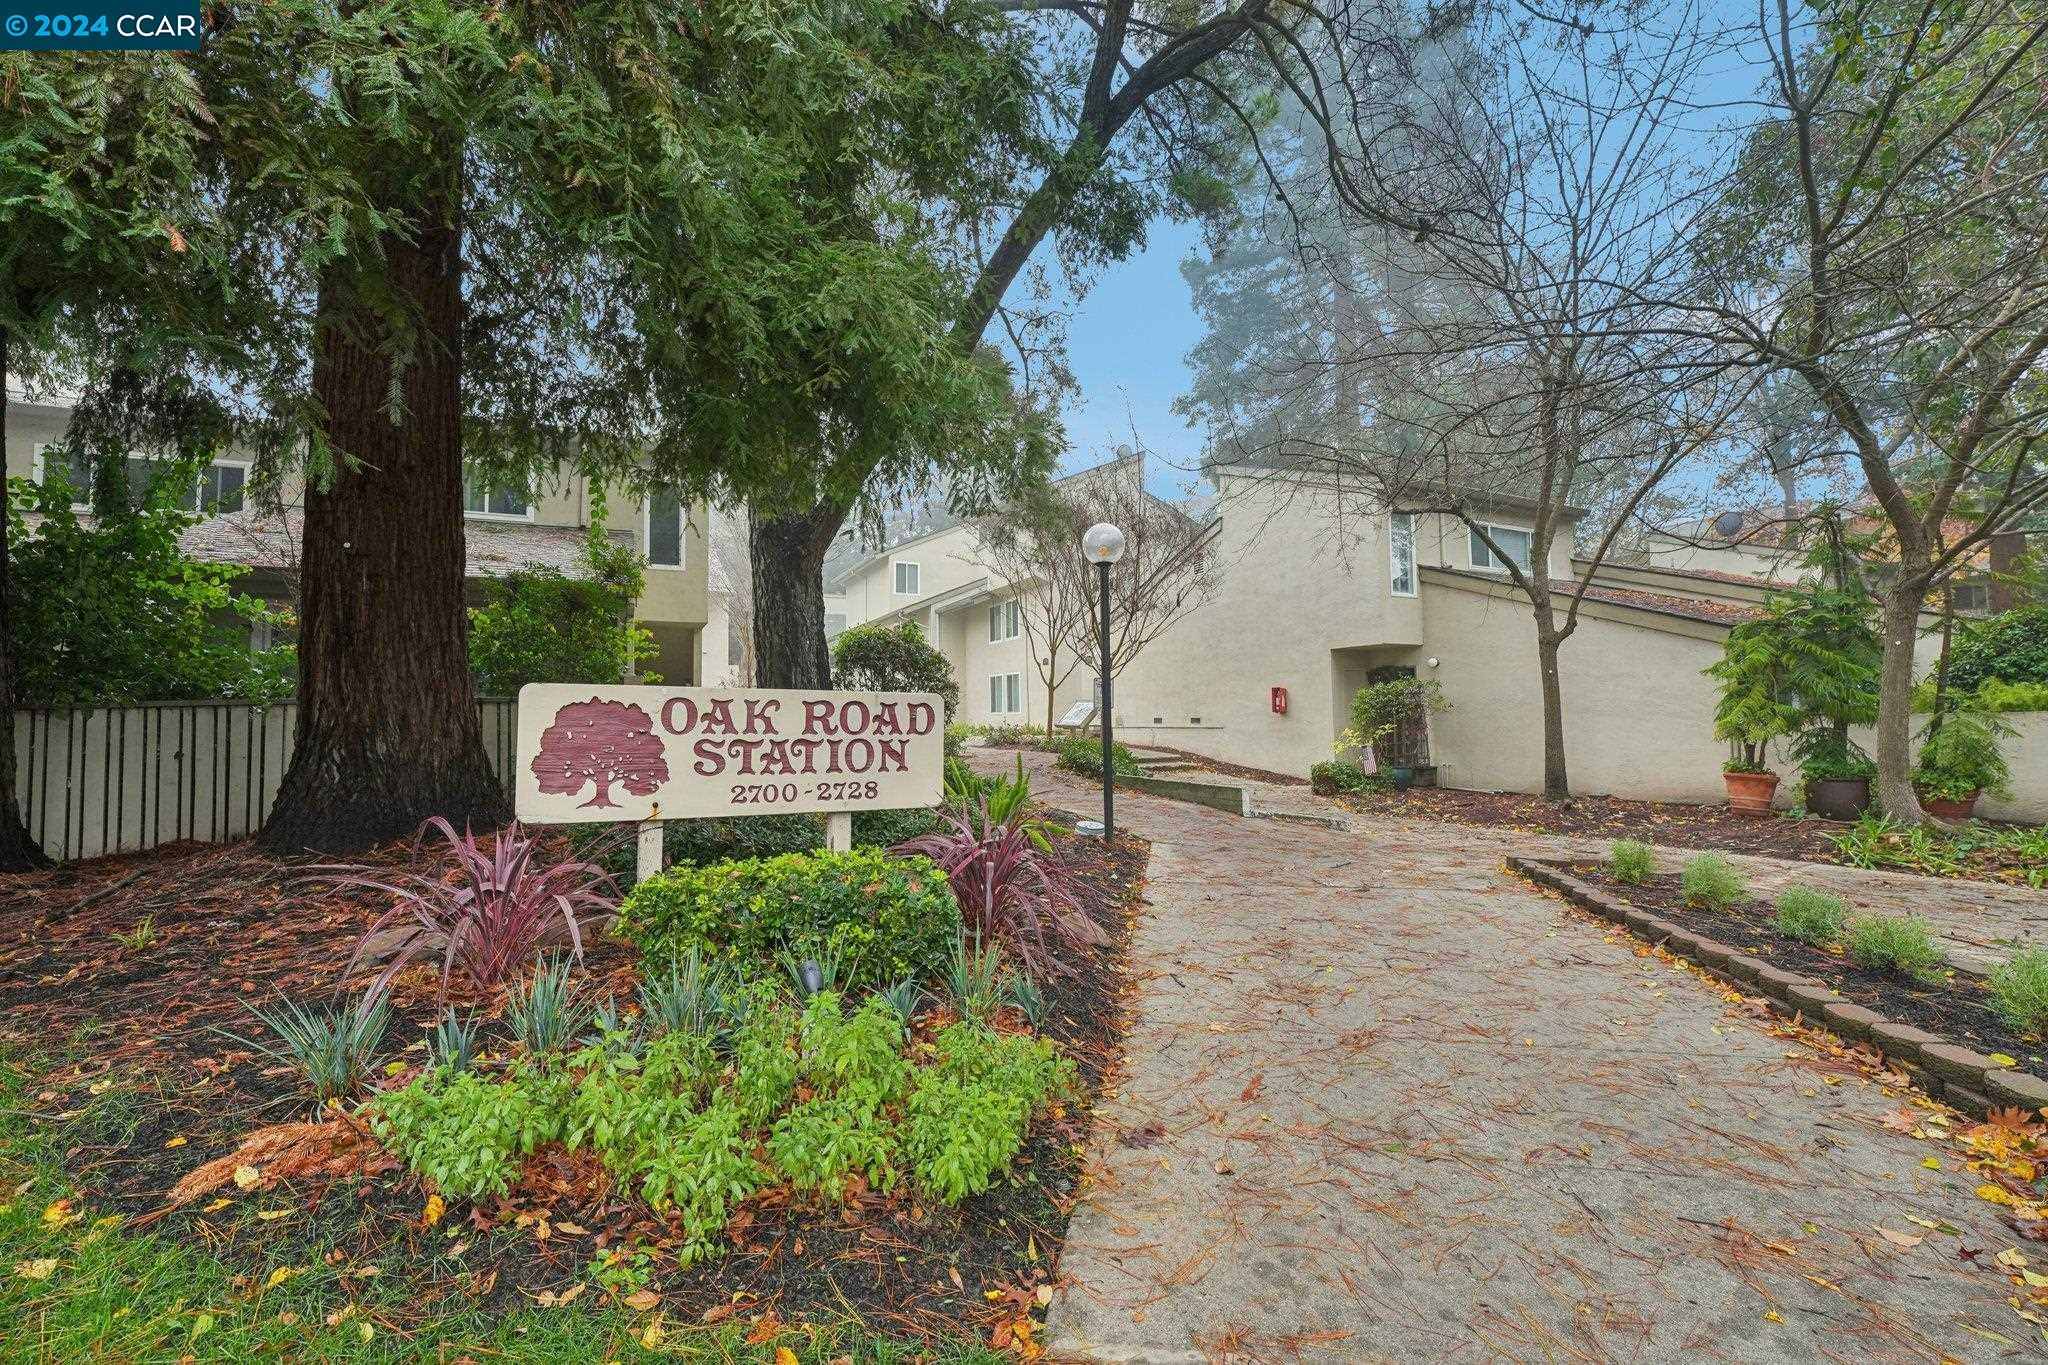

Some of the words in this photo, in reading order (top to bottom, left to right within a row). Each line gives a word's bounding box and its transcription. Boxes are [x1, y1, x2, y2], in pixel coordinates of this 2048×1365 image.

[660, 696, 781, 737] OAK
[801, 699, 936, 737] ROAD
[693, 738, 911, 777] STATION
